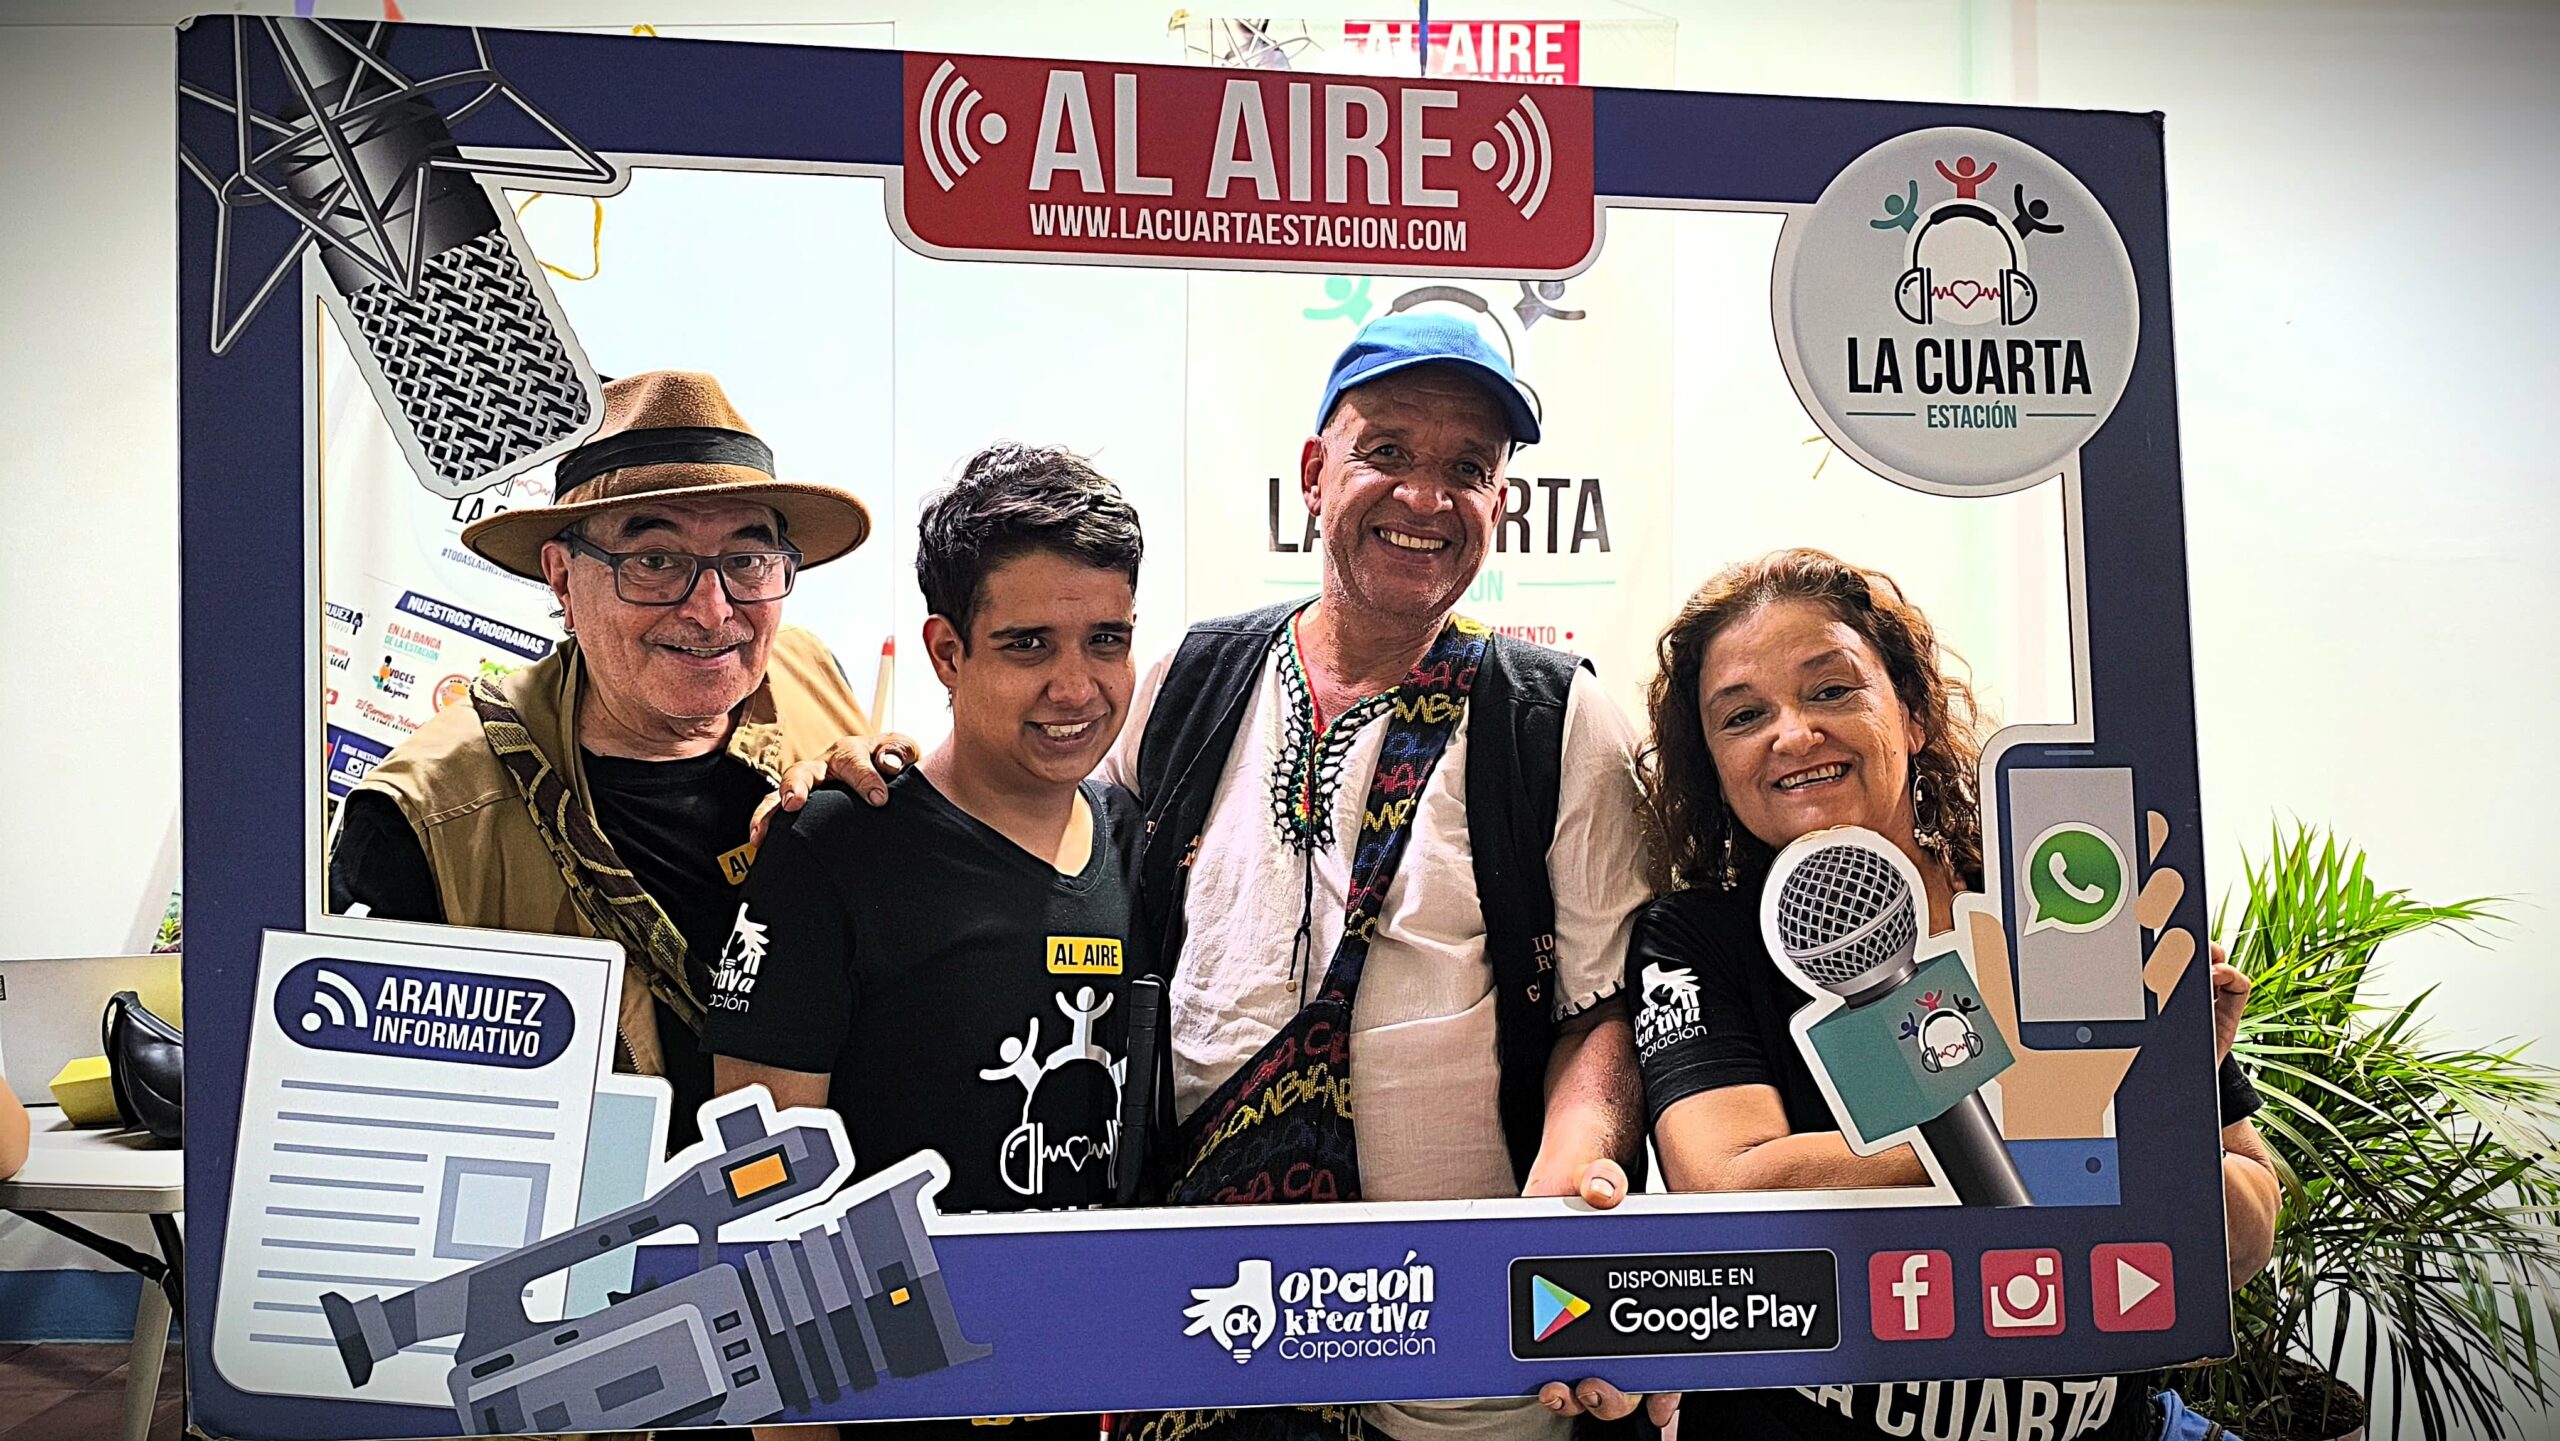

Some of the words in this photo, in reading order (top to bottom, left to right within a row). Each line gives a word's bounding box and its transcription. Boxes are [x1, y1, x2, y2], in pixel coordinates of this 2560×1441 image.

[1443, 24, 1566, 73] AIRE
[1028, 69, 1173, 196] AL
[1205, 79, 1459, 209] AIRE
[1028, 202, 1468, 252] WWW.LACUARTAESTACION.COM
[1847, 337, 1904, 395] LA
[1915, 338, 2093, 396] CUARTA
[1926, 400, 2018, 429] ESTACIÓN
[1495, 478, 1611, 553] RTA
[407, 595, 473, 629] NUESTROS
[471, 616, 546, 655] PROGRAMAS
[1053, 943, 1078, 967] AL
[1083, 944, 1119, 968] AIRE
[376, 975, 547, 1029] ARANJUEZ
[372, 1014, 541, 1059] INFORMATIVO
[1640, 1023, 1708, 1068] poración
[1279, 1249, 1434, 1308] opción
[1608, 1268, 1723, 1290] DISPONIBLE
[1728, 1267, 1755, 1286] EN
[1609, 1295, 1739, 1341] Google
[1746, 1292, 1818, 1337] Play
[1278, 1331, 1436, 1363] Corporación
